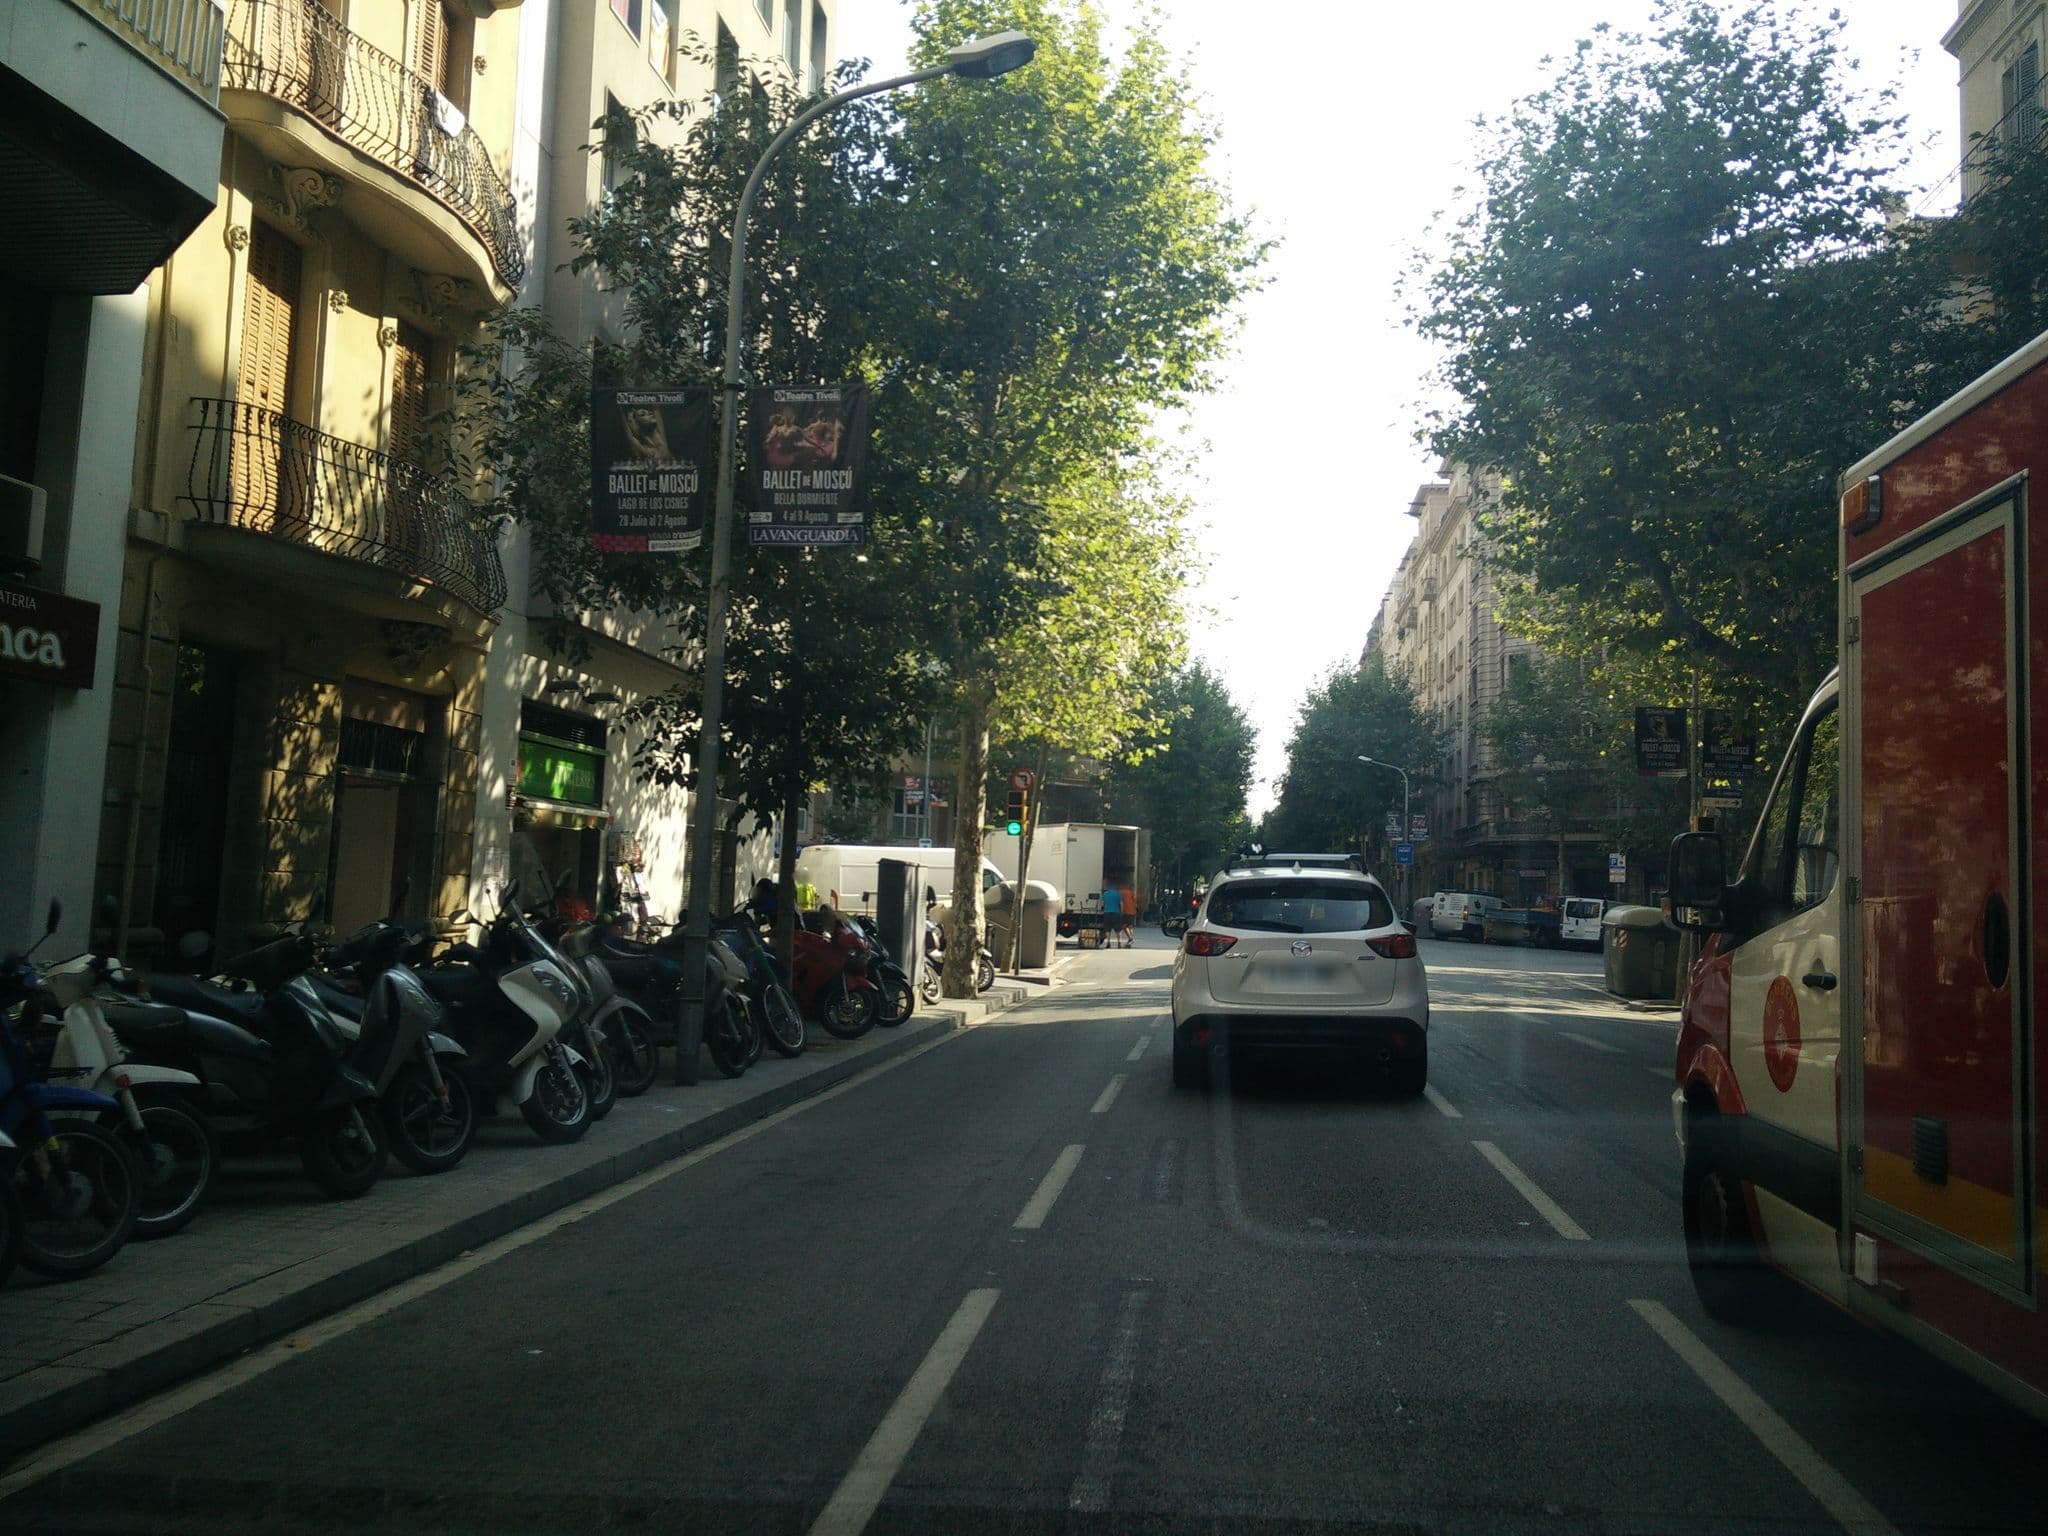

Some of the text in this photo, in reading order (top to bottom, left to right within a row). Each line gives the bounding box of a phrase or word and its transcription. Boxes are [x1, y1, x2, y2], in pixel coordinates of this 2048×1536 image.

[629, 393, 683, 402] Teatre Tivoli
[785, 390, 840, 400] Teatre Tivoli
[608, 470, 698, 494] BALLET DE MOSCÚ
[763, 466, 853, 489] BALLET DE MOSCÚ
[618, 497, 637, 509] LAGO
[649, 497, 663, 509] LOS
[774, 492, 796, 505] BELLA
[753, 528, 860, 541] LA VANGUARDIA
